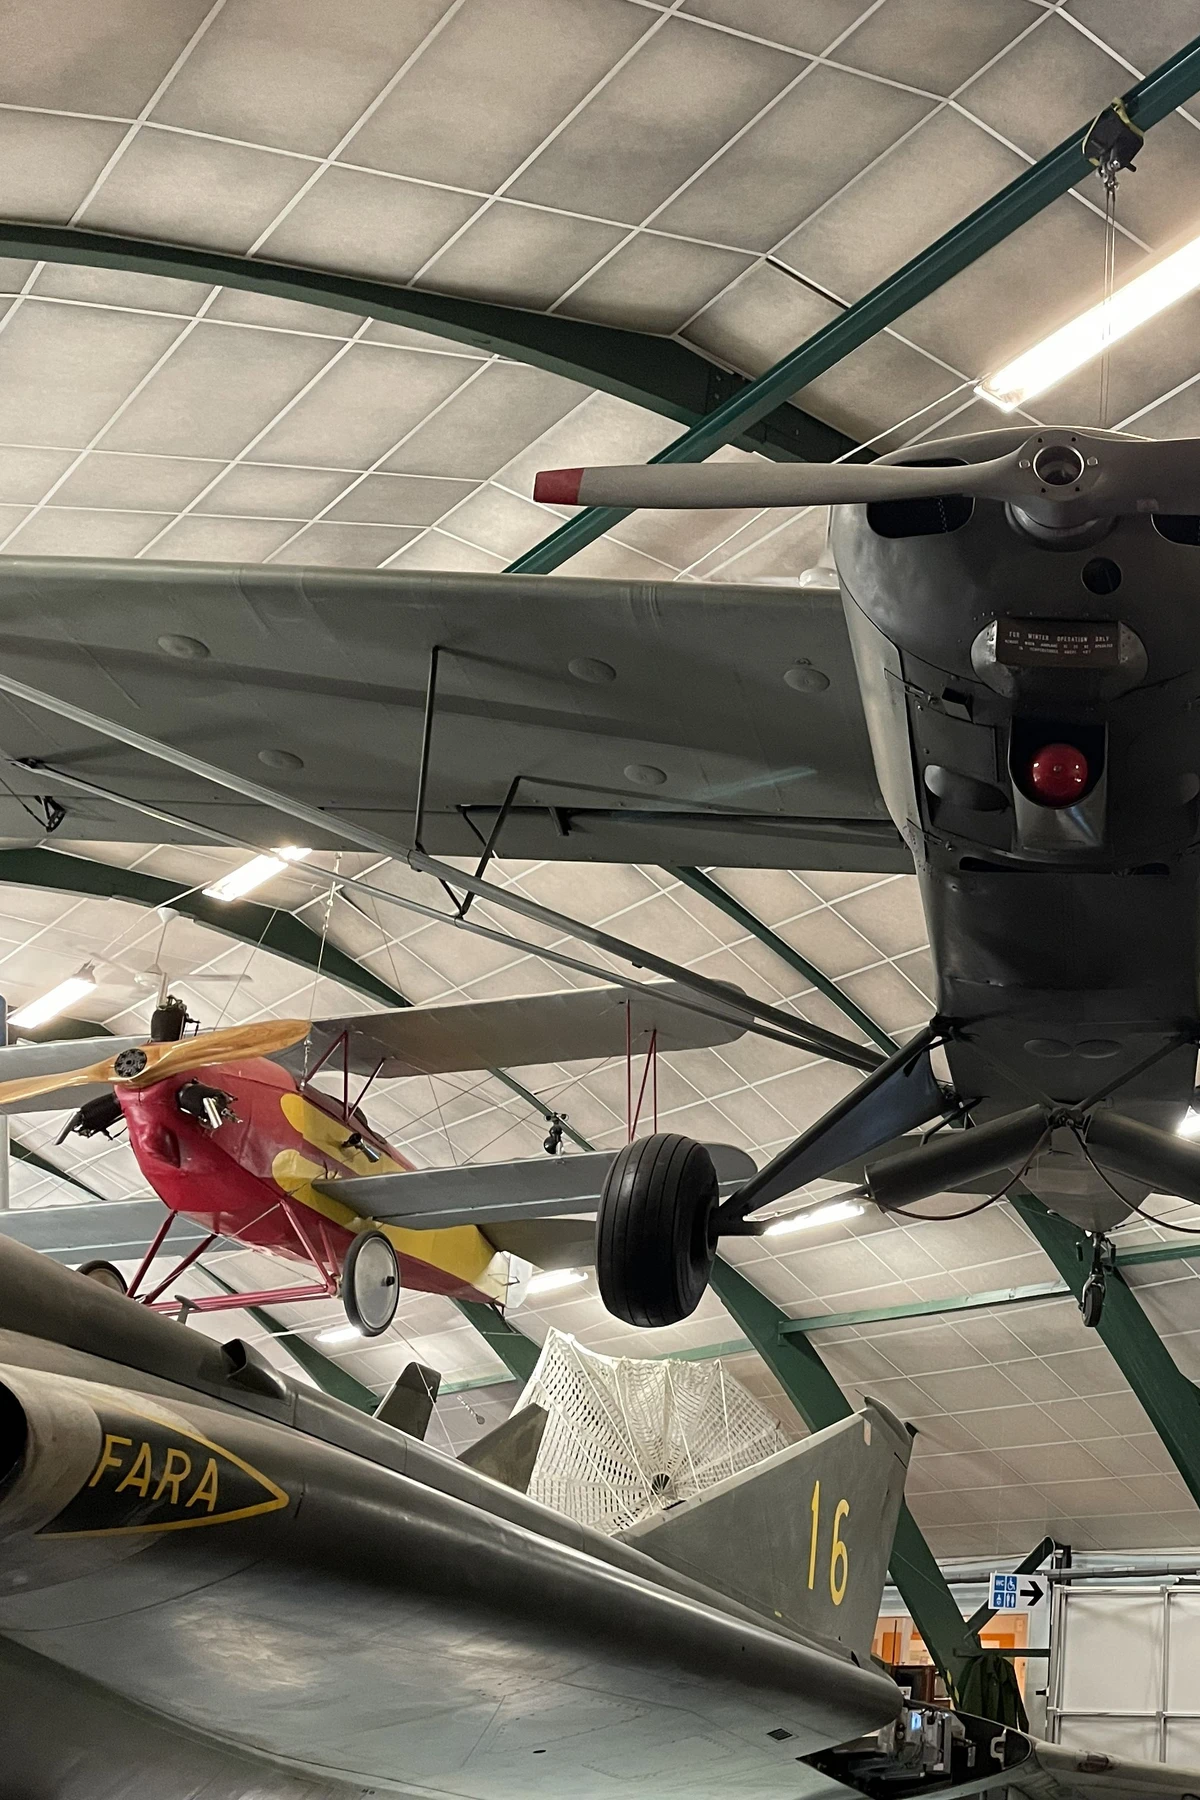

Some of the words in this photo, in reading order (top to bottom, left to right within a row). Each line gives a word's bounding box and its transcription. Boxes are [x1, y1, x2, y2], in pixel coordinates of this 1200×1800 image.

[1028, 633, 1050, 641] WINTER
[88, 1433, 218, 1512] FARA
[808, 1479, 850, 1606] 16
[995, 1579, 1006, 1587] WC
